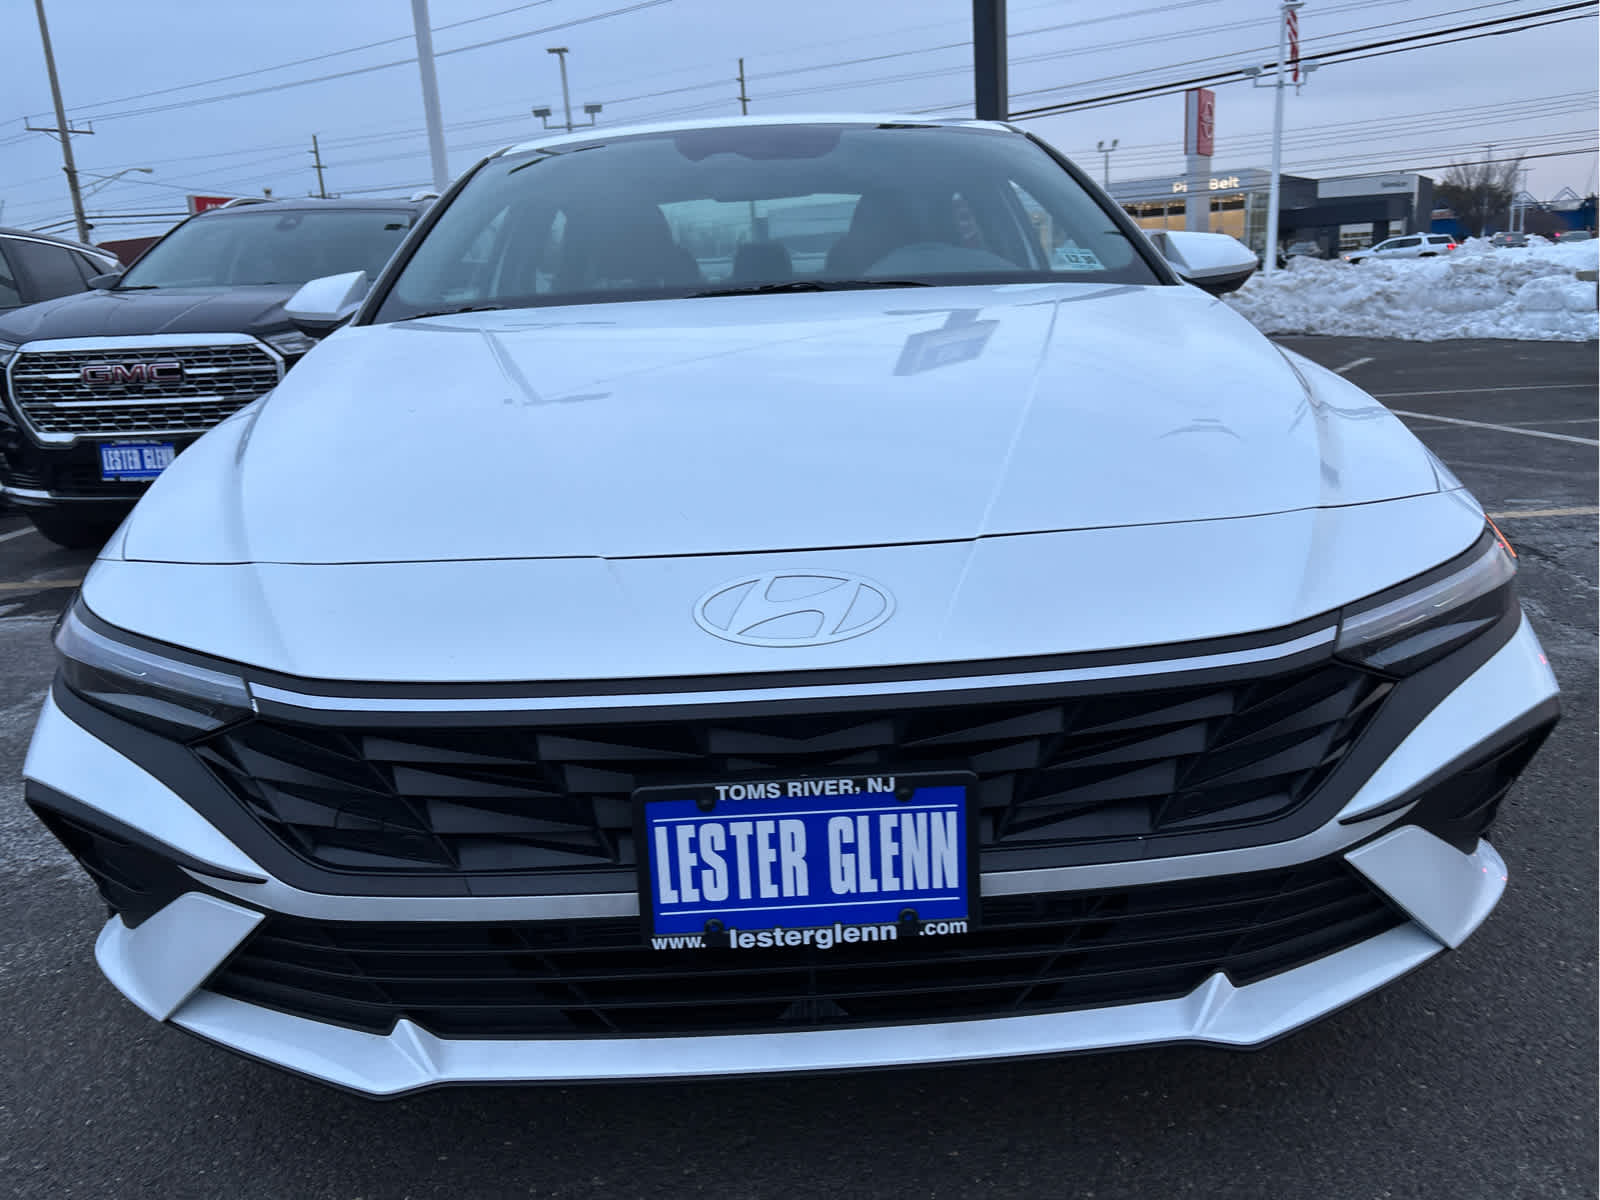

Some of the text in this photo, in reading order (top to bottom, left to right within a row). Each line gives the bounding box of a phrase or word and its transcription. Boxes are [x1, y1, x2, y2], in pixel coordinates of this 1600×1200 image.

[1208, 176, 1240, 190] Belt
[81, 362, 180, 384] GMC
[103, 449, 142, 471] LESTER
[715, 776, 896, 801] TOMS RIVER, NJ
[654, 811, 959, 904] LESTER GLENN
[651, 920, 968, 951] www. lesterglenn .com
